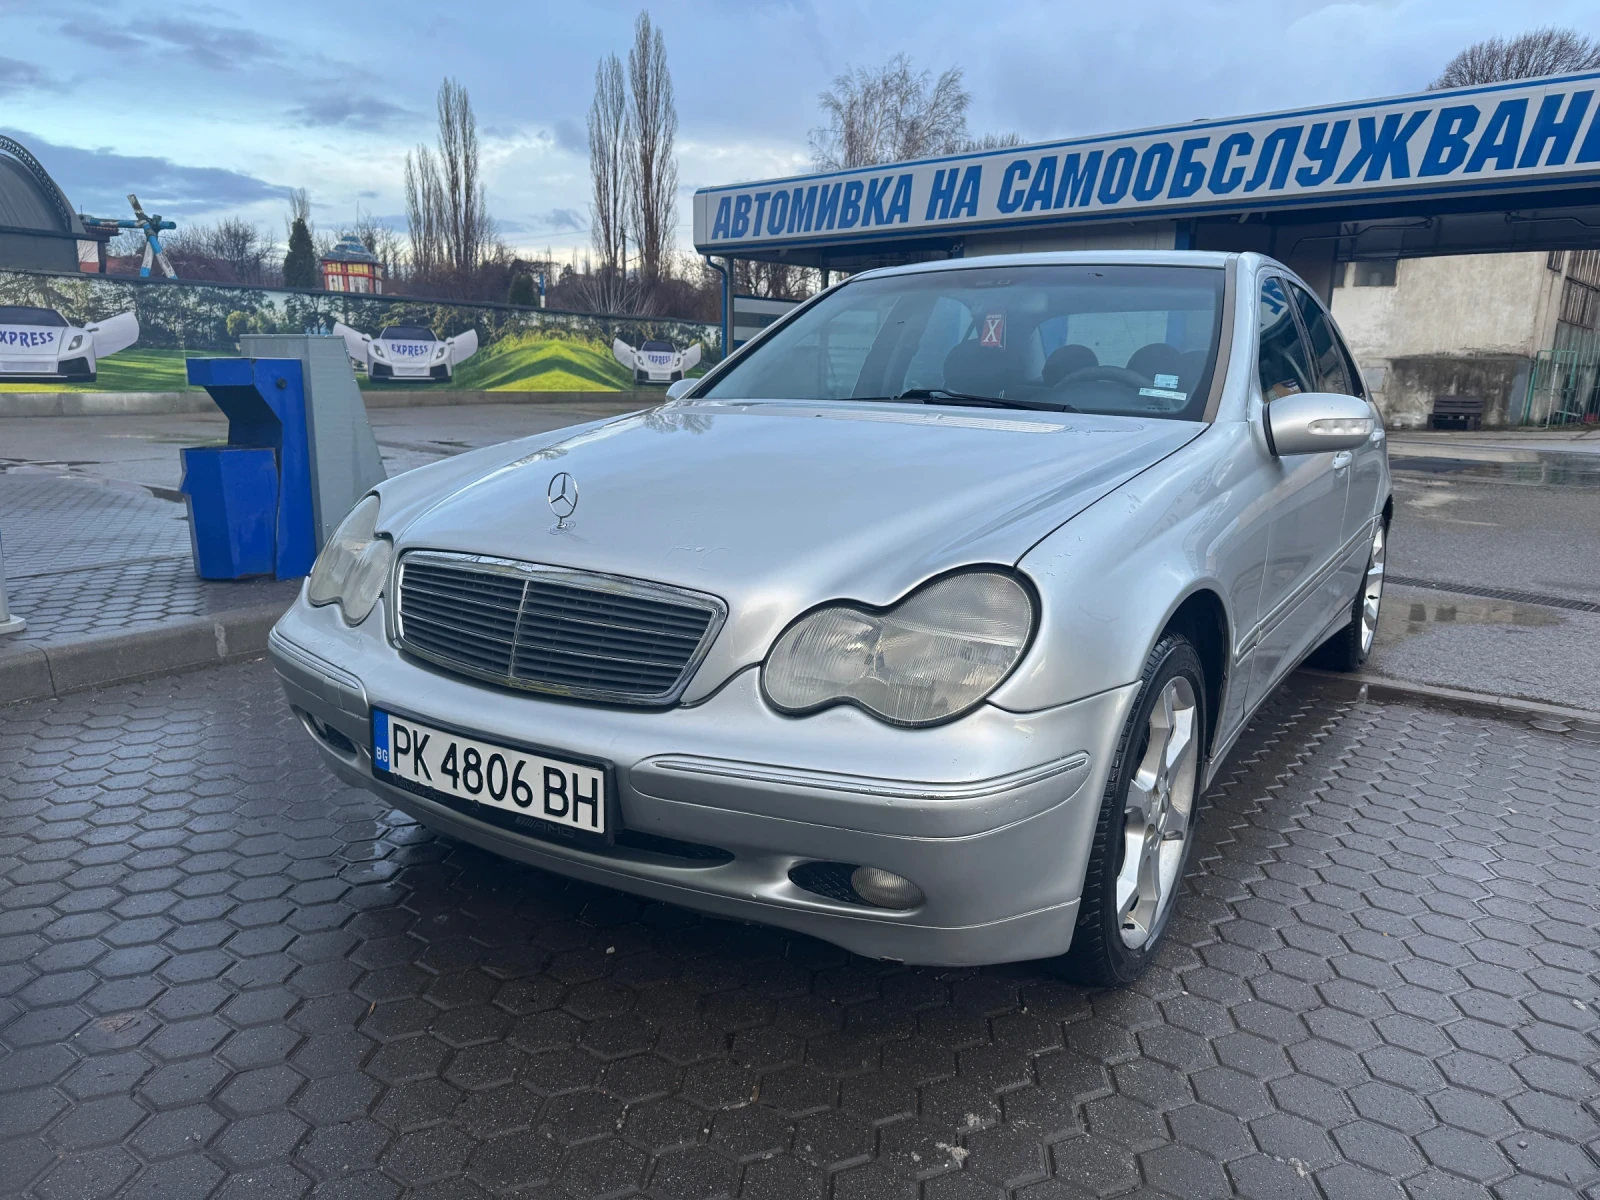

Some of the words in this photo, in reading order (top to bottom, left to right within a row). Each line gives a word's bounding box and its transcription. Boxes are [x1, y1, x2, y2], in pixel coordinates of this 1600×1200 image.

[711, 173, 914, 240] АВТОМИВКА
[924, 164, 983, 221] НА
[982, 319, 1001, 343] X
[391, 343, 428, 357] EXPRESS
[376, 746, 388, 763] BG
[393, 722, 431, 781] PK
[441, 742, 533, 808] 4806
[543, 765, 598, 829] BH
